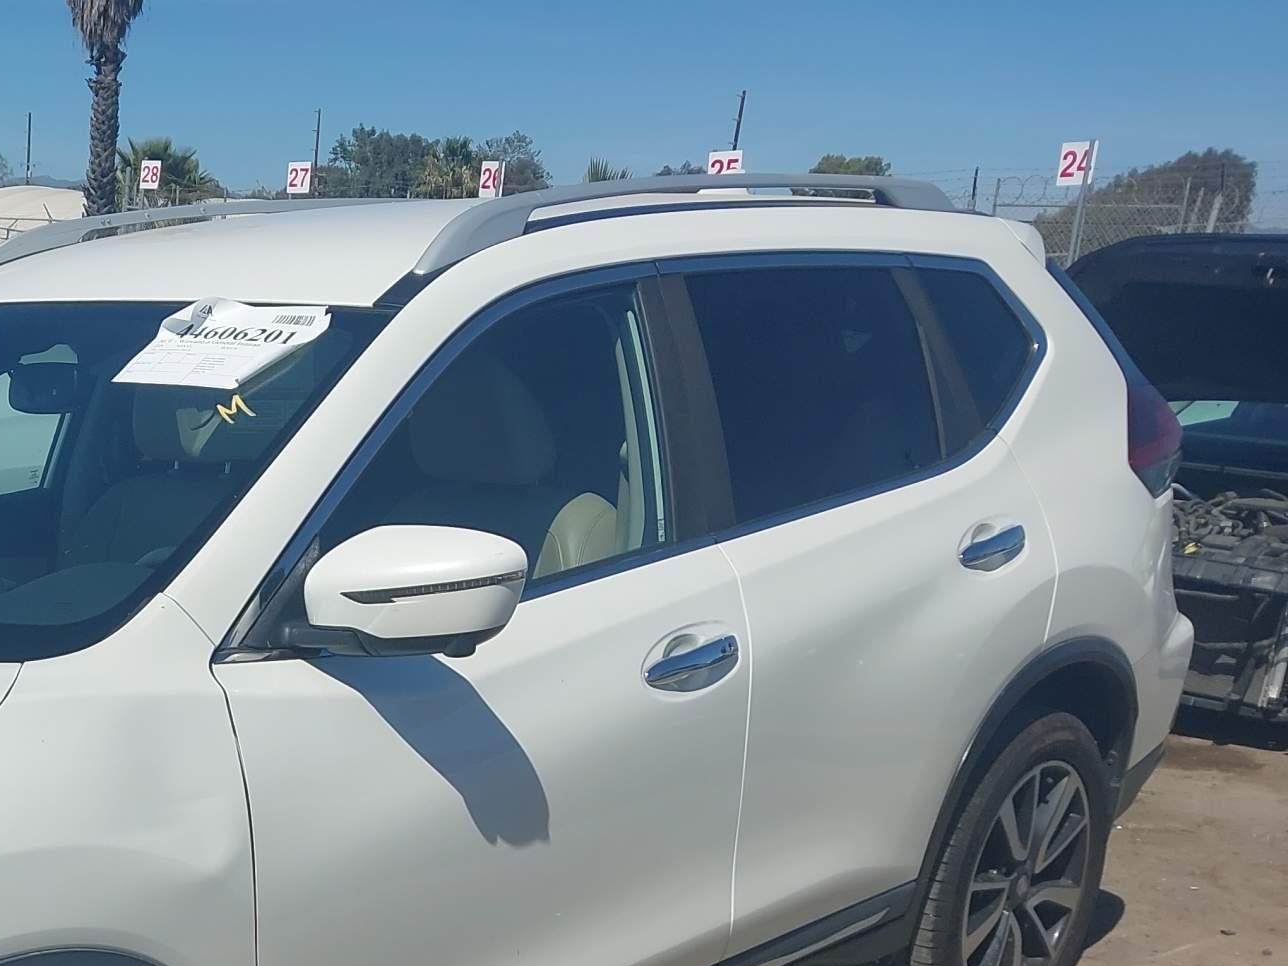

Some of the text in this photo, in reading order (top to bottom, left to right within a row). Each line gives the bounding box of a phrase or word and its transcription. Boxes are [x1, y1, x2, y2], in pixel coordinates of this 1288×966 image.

[142, 166, 159, 183] 28
[1060, 150, 1089, 177] 24
[289, 168, 309, 188] 27
[176, 323, 298, 345] 44606201
[216, 394, 256, 424] M
